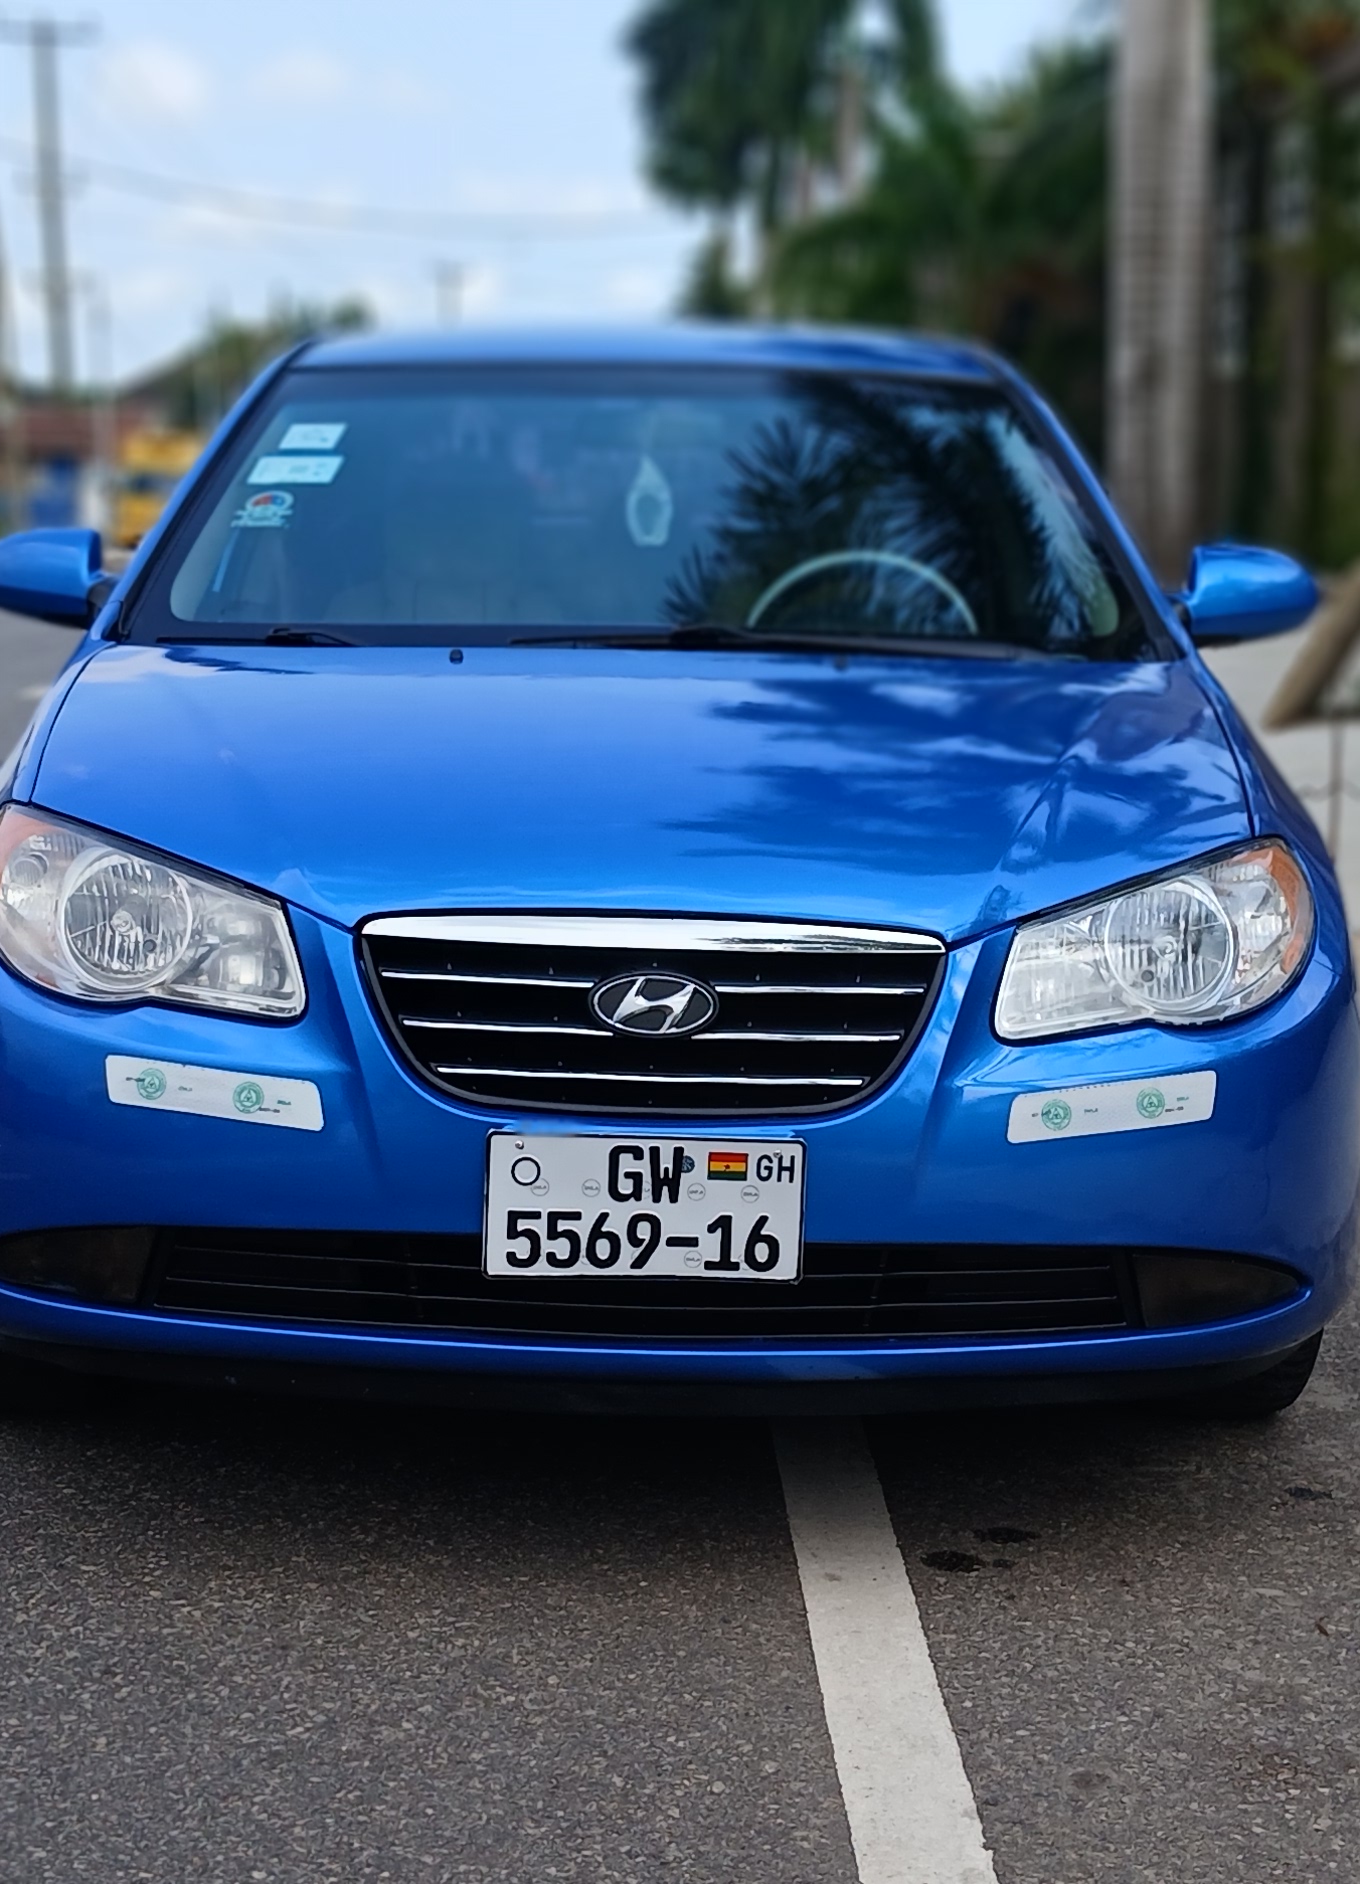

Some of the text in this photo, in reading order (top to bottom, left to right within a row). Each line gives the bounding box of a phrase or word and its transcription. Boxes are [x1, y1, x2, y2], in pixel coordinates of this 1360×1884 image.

[607, 1144, 685, 1203] GW
[756, 1154, 796, 1184] GH
[505, 1209, 781, 1273] 5569-16
